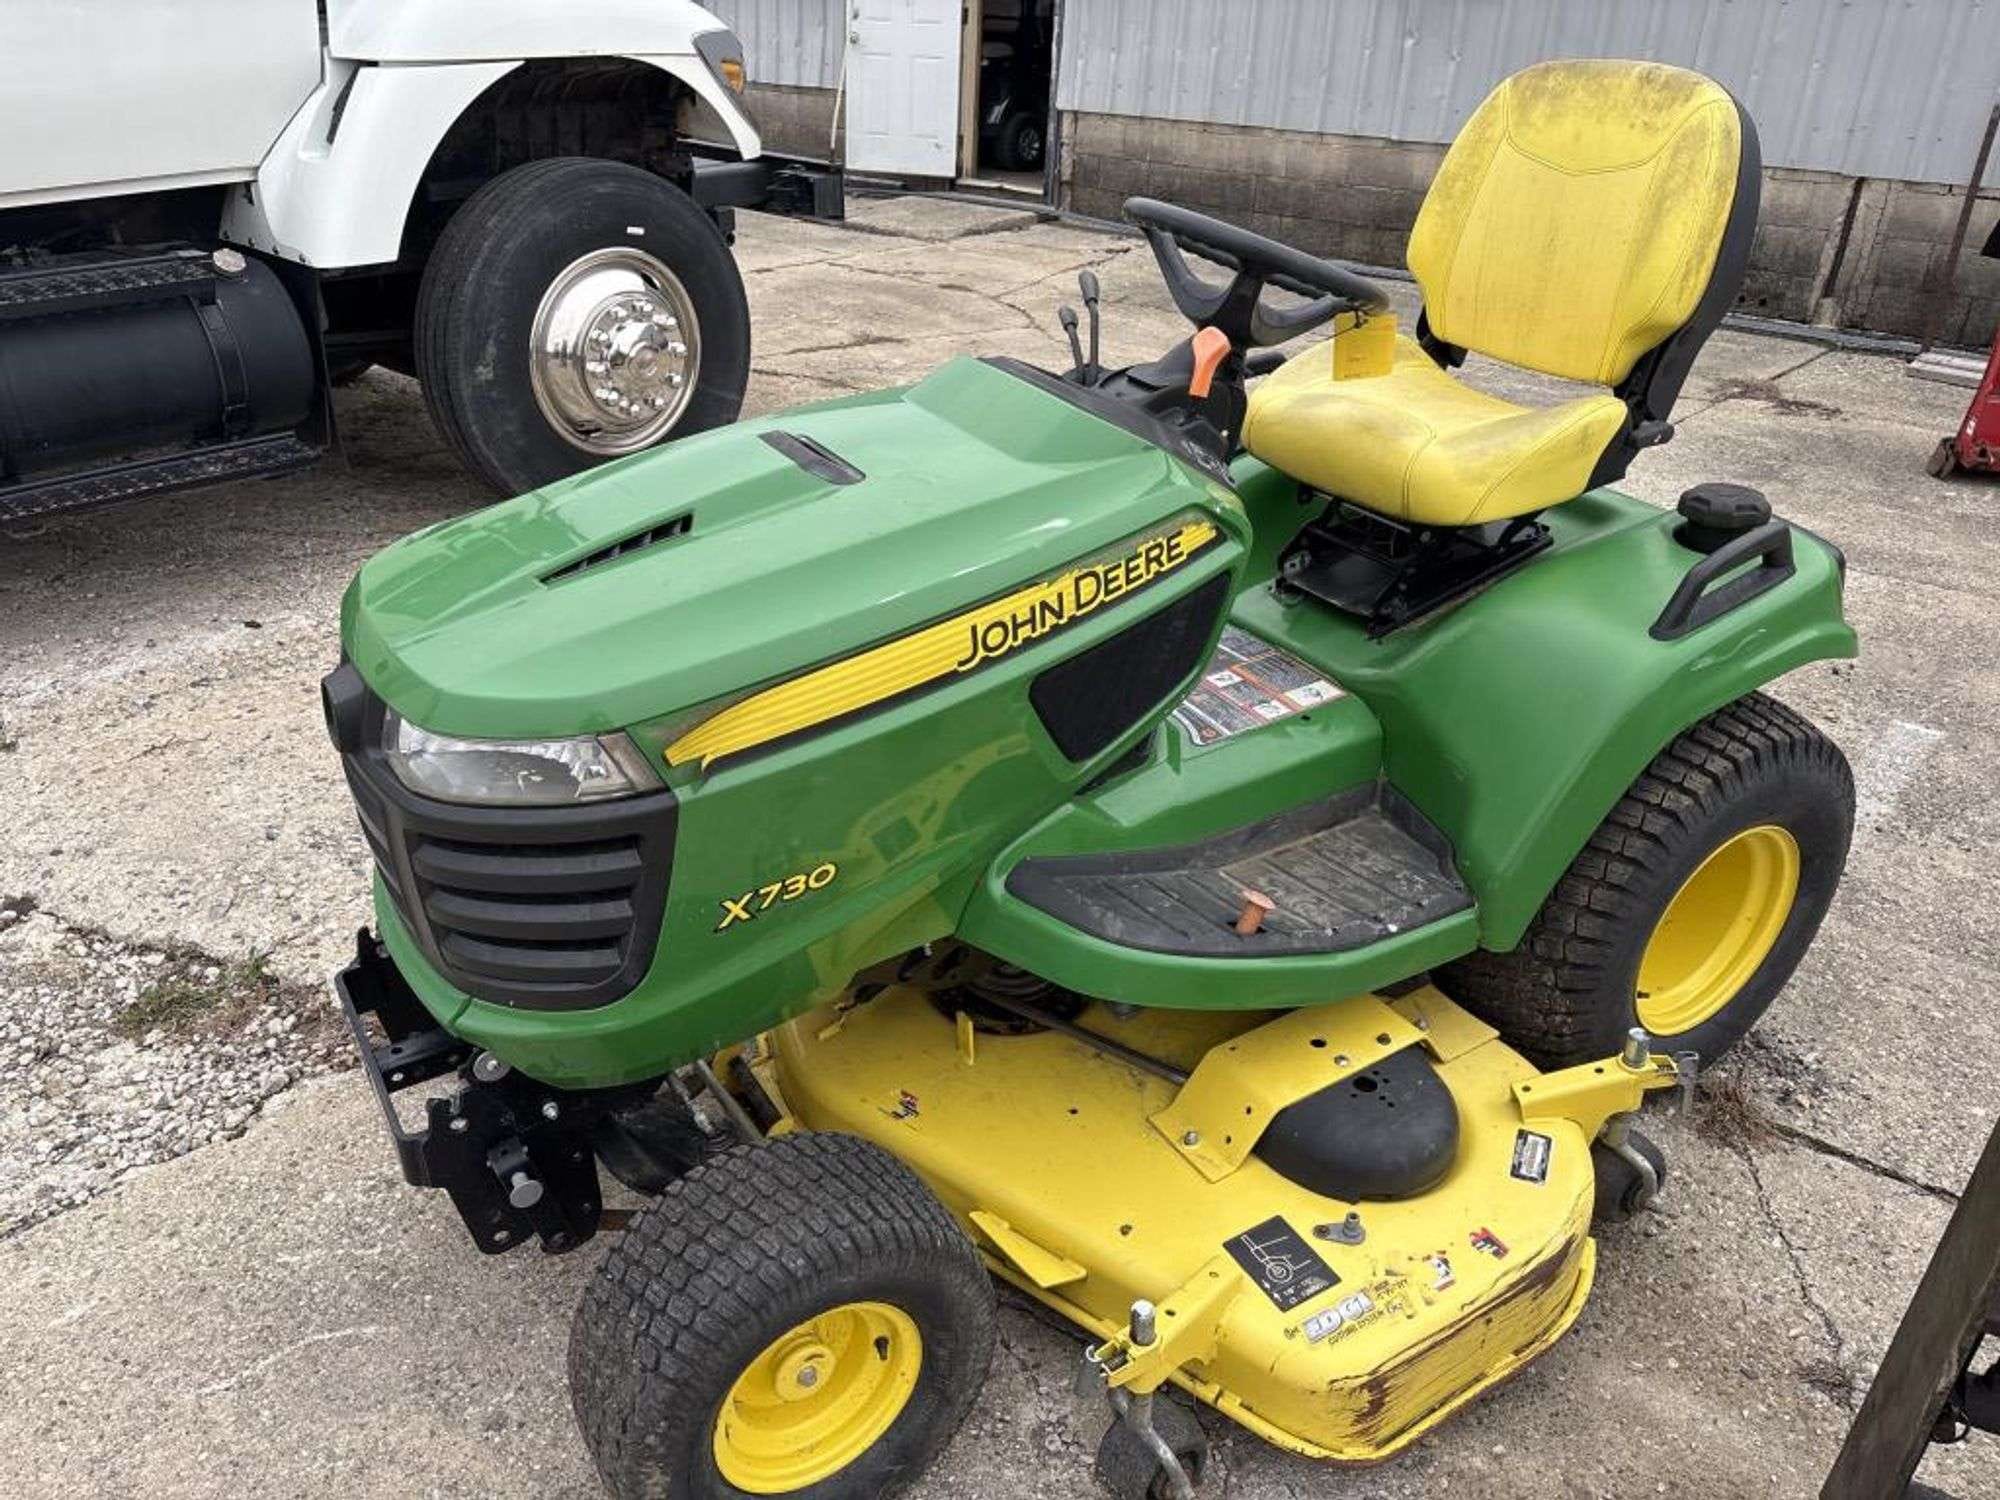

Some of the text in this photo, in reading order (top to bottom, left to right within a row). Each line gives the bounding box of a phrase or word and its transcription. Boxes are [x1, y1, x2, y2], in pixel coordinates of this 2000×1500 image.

[958, 529, 1184, 668] JOHN DEERE
[717, 862, 837, 931] X730
